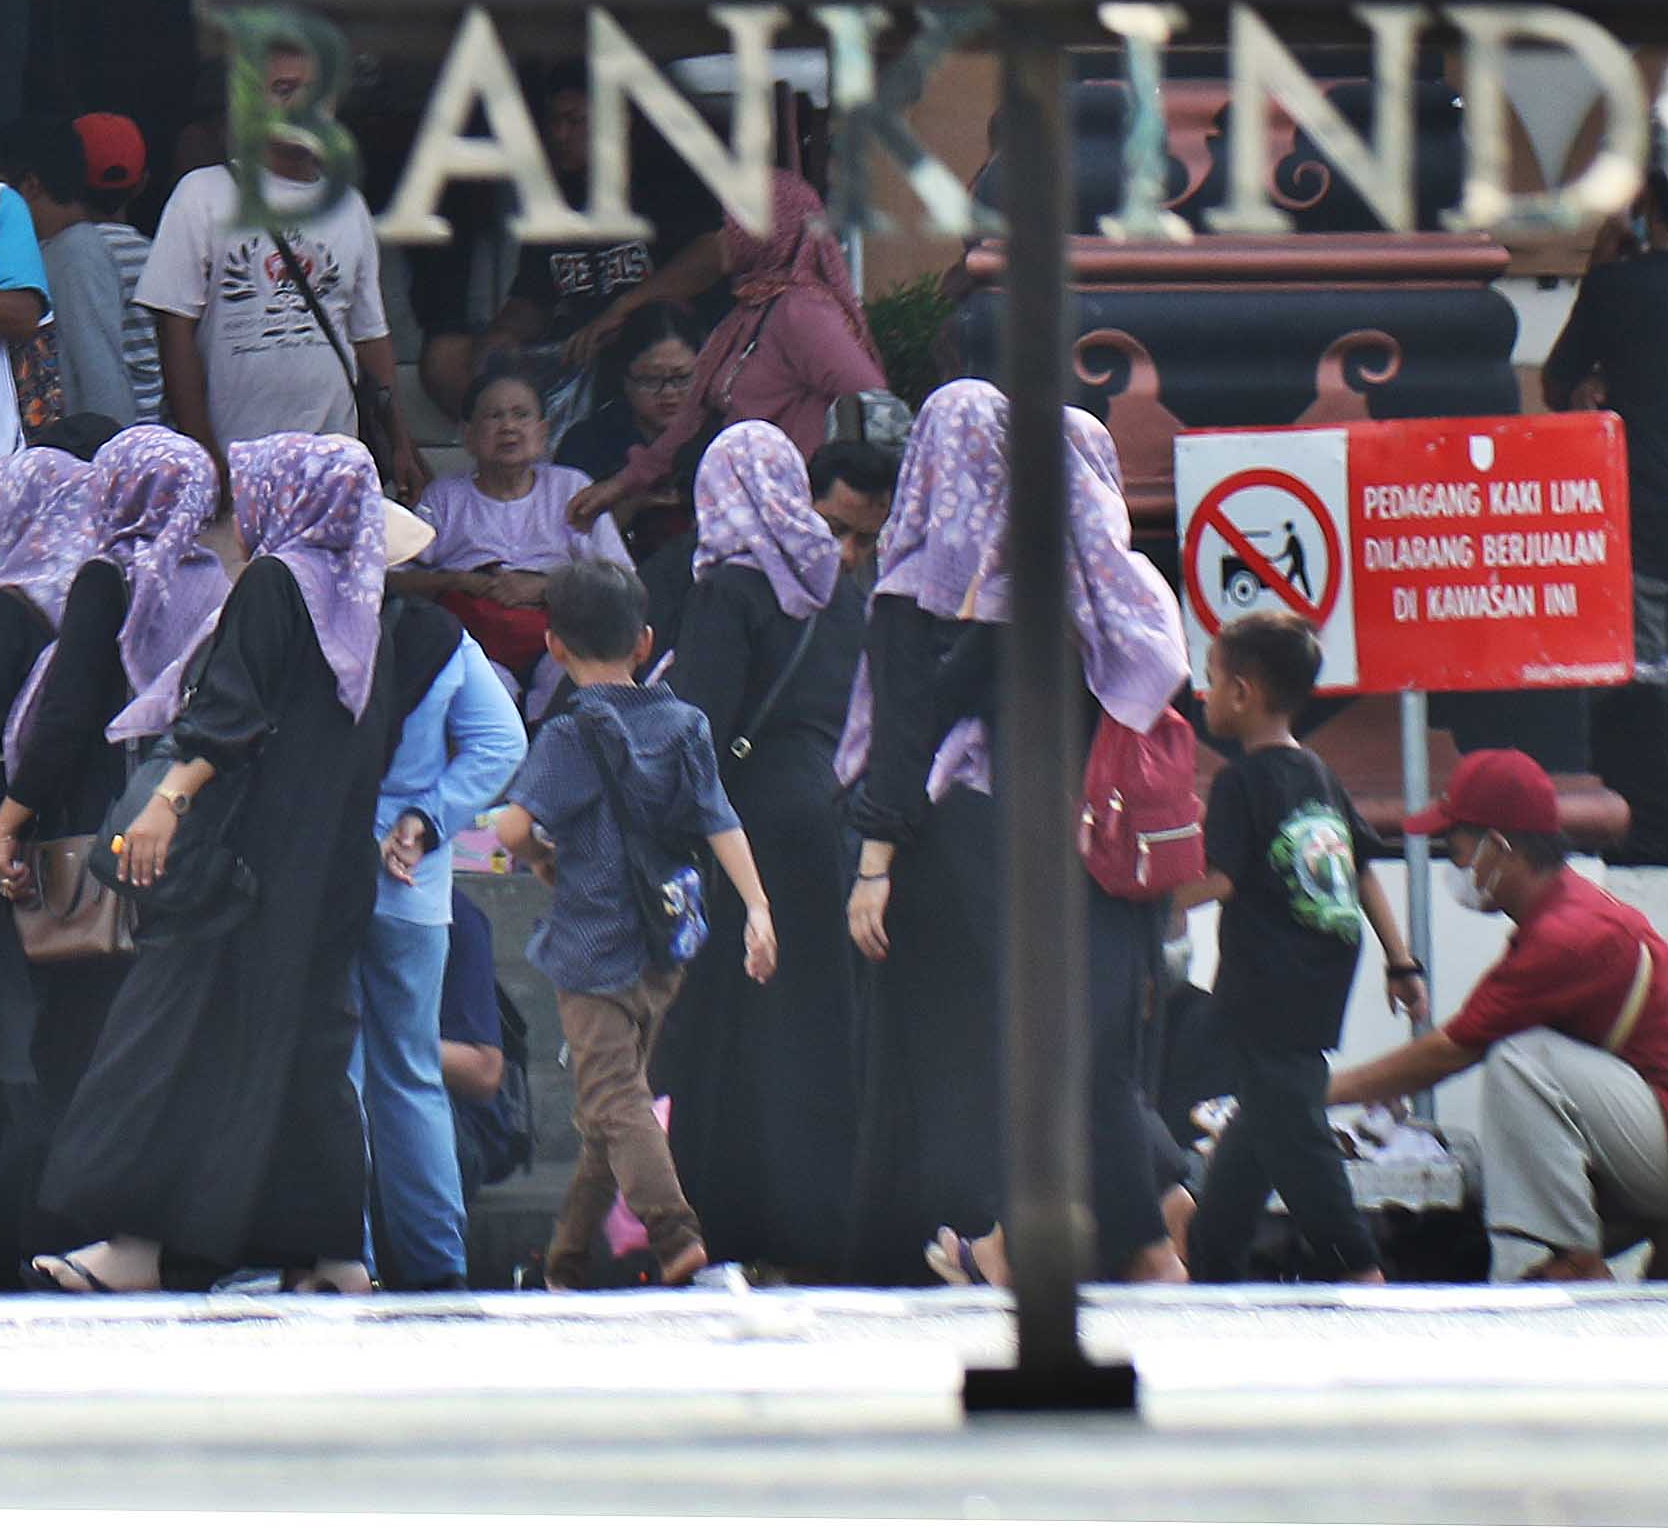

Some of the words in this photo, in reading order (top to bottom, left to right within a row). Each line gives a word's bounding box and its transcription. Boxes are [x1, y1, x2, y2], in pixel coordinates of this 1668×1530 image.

[210, 0, 1011, 246] BANK
[1096, 0, 1668, 246] IND
[1363, 482, 1482, 520] PEDAGANG
[1489, 480, 1542, 516] KAKI
[1549, 477, 1605, 515] LIMA
[1364, 533, 1475, 571] DILARANG
[1482, 529, 1607, 568] BERJUALAN
[1392, 585, 1419, 623] DI
[1426, 582, 1536, 622] KAWASAN
[1543, 581, 1579, 618] INI
